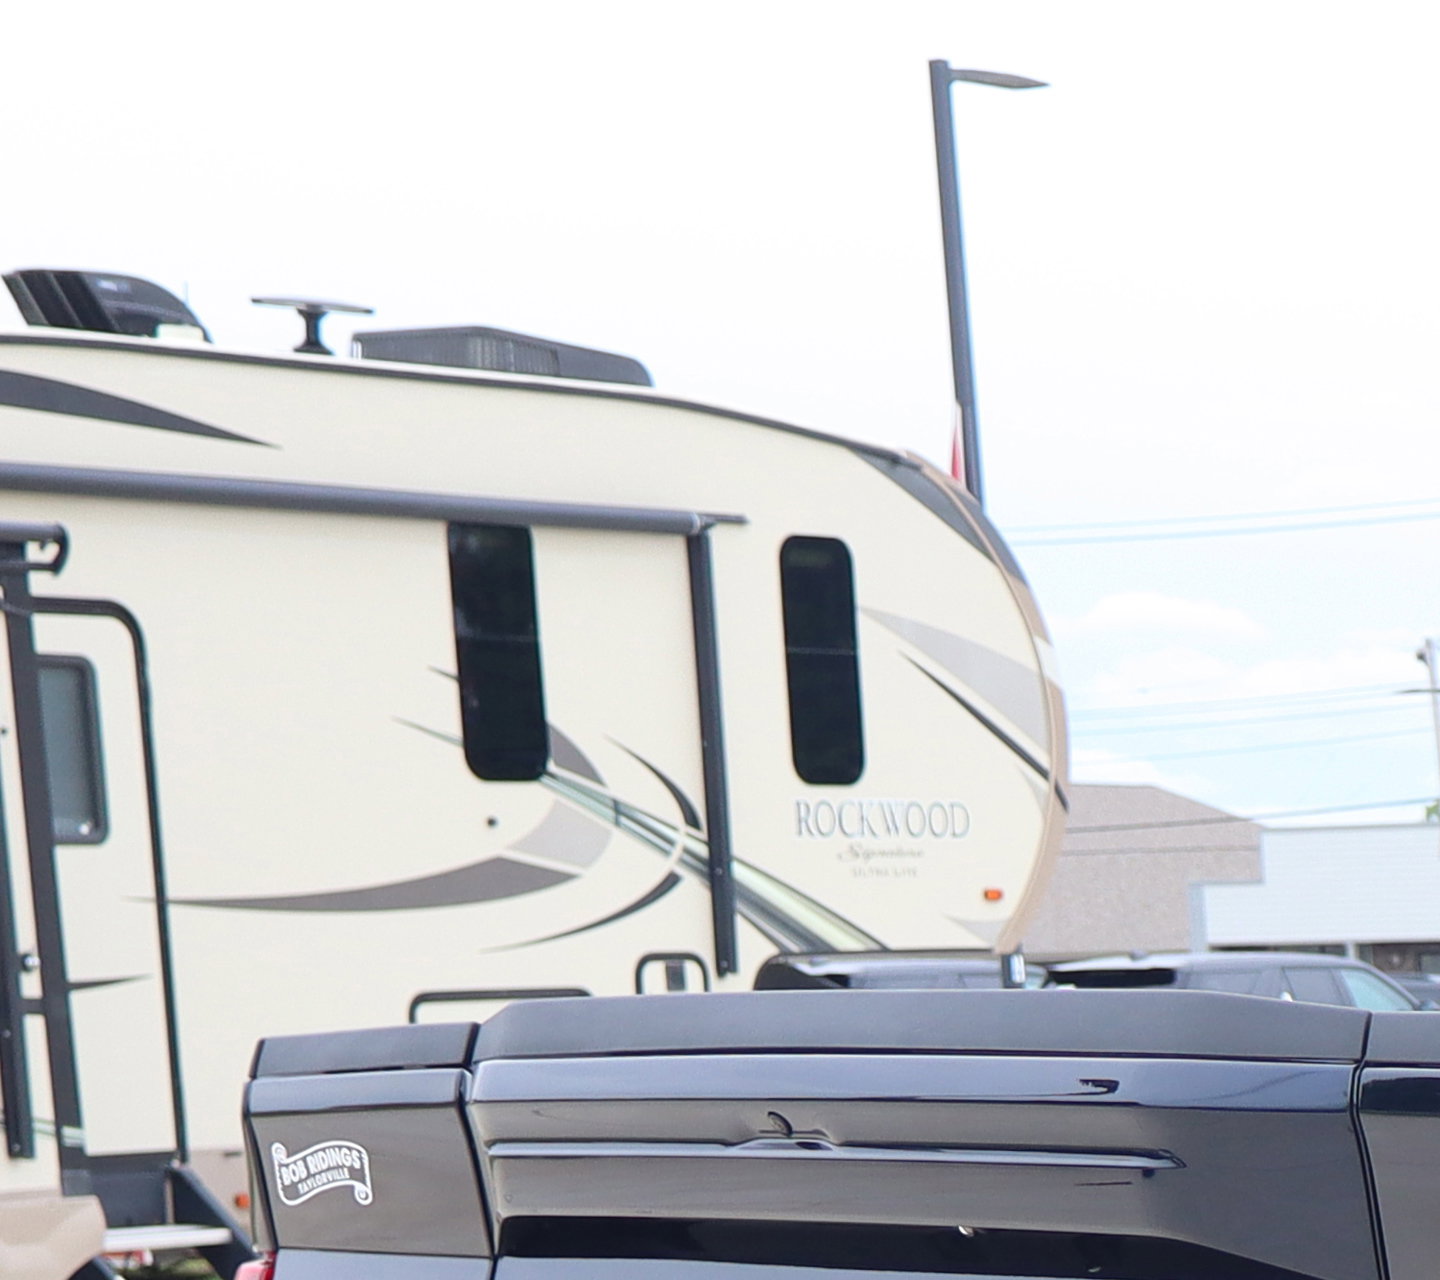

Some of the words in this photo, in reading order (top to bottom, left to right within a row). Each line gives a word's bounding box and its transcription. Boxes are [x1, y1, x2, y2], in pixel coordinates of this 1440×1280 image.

[796, 799, 971, 839] ROCKWOOD
[280, 1159, 308, 1186] BOB
[305, 1146, 362, 1175] RIDINGS
[297, 1167, 351, 1195] TAYLORVILLE
